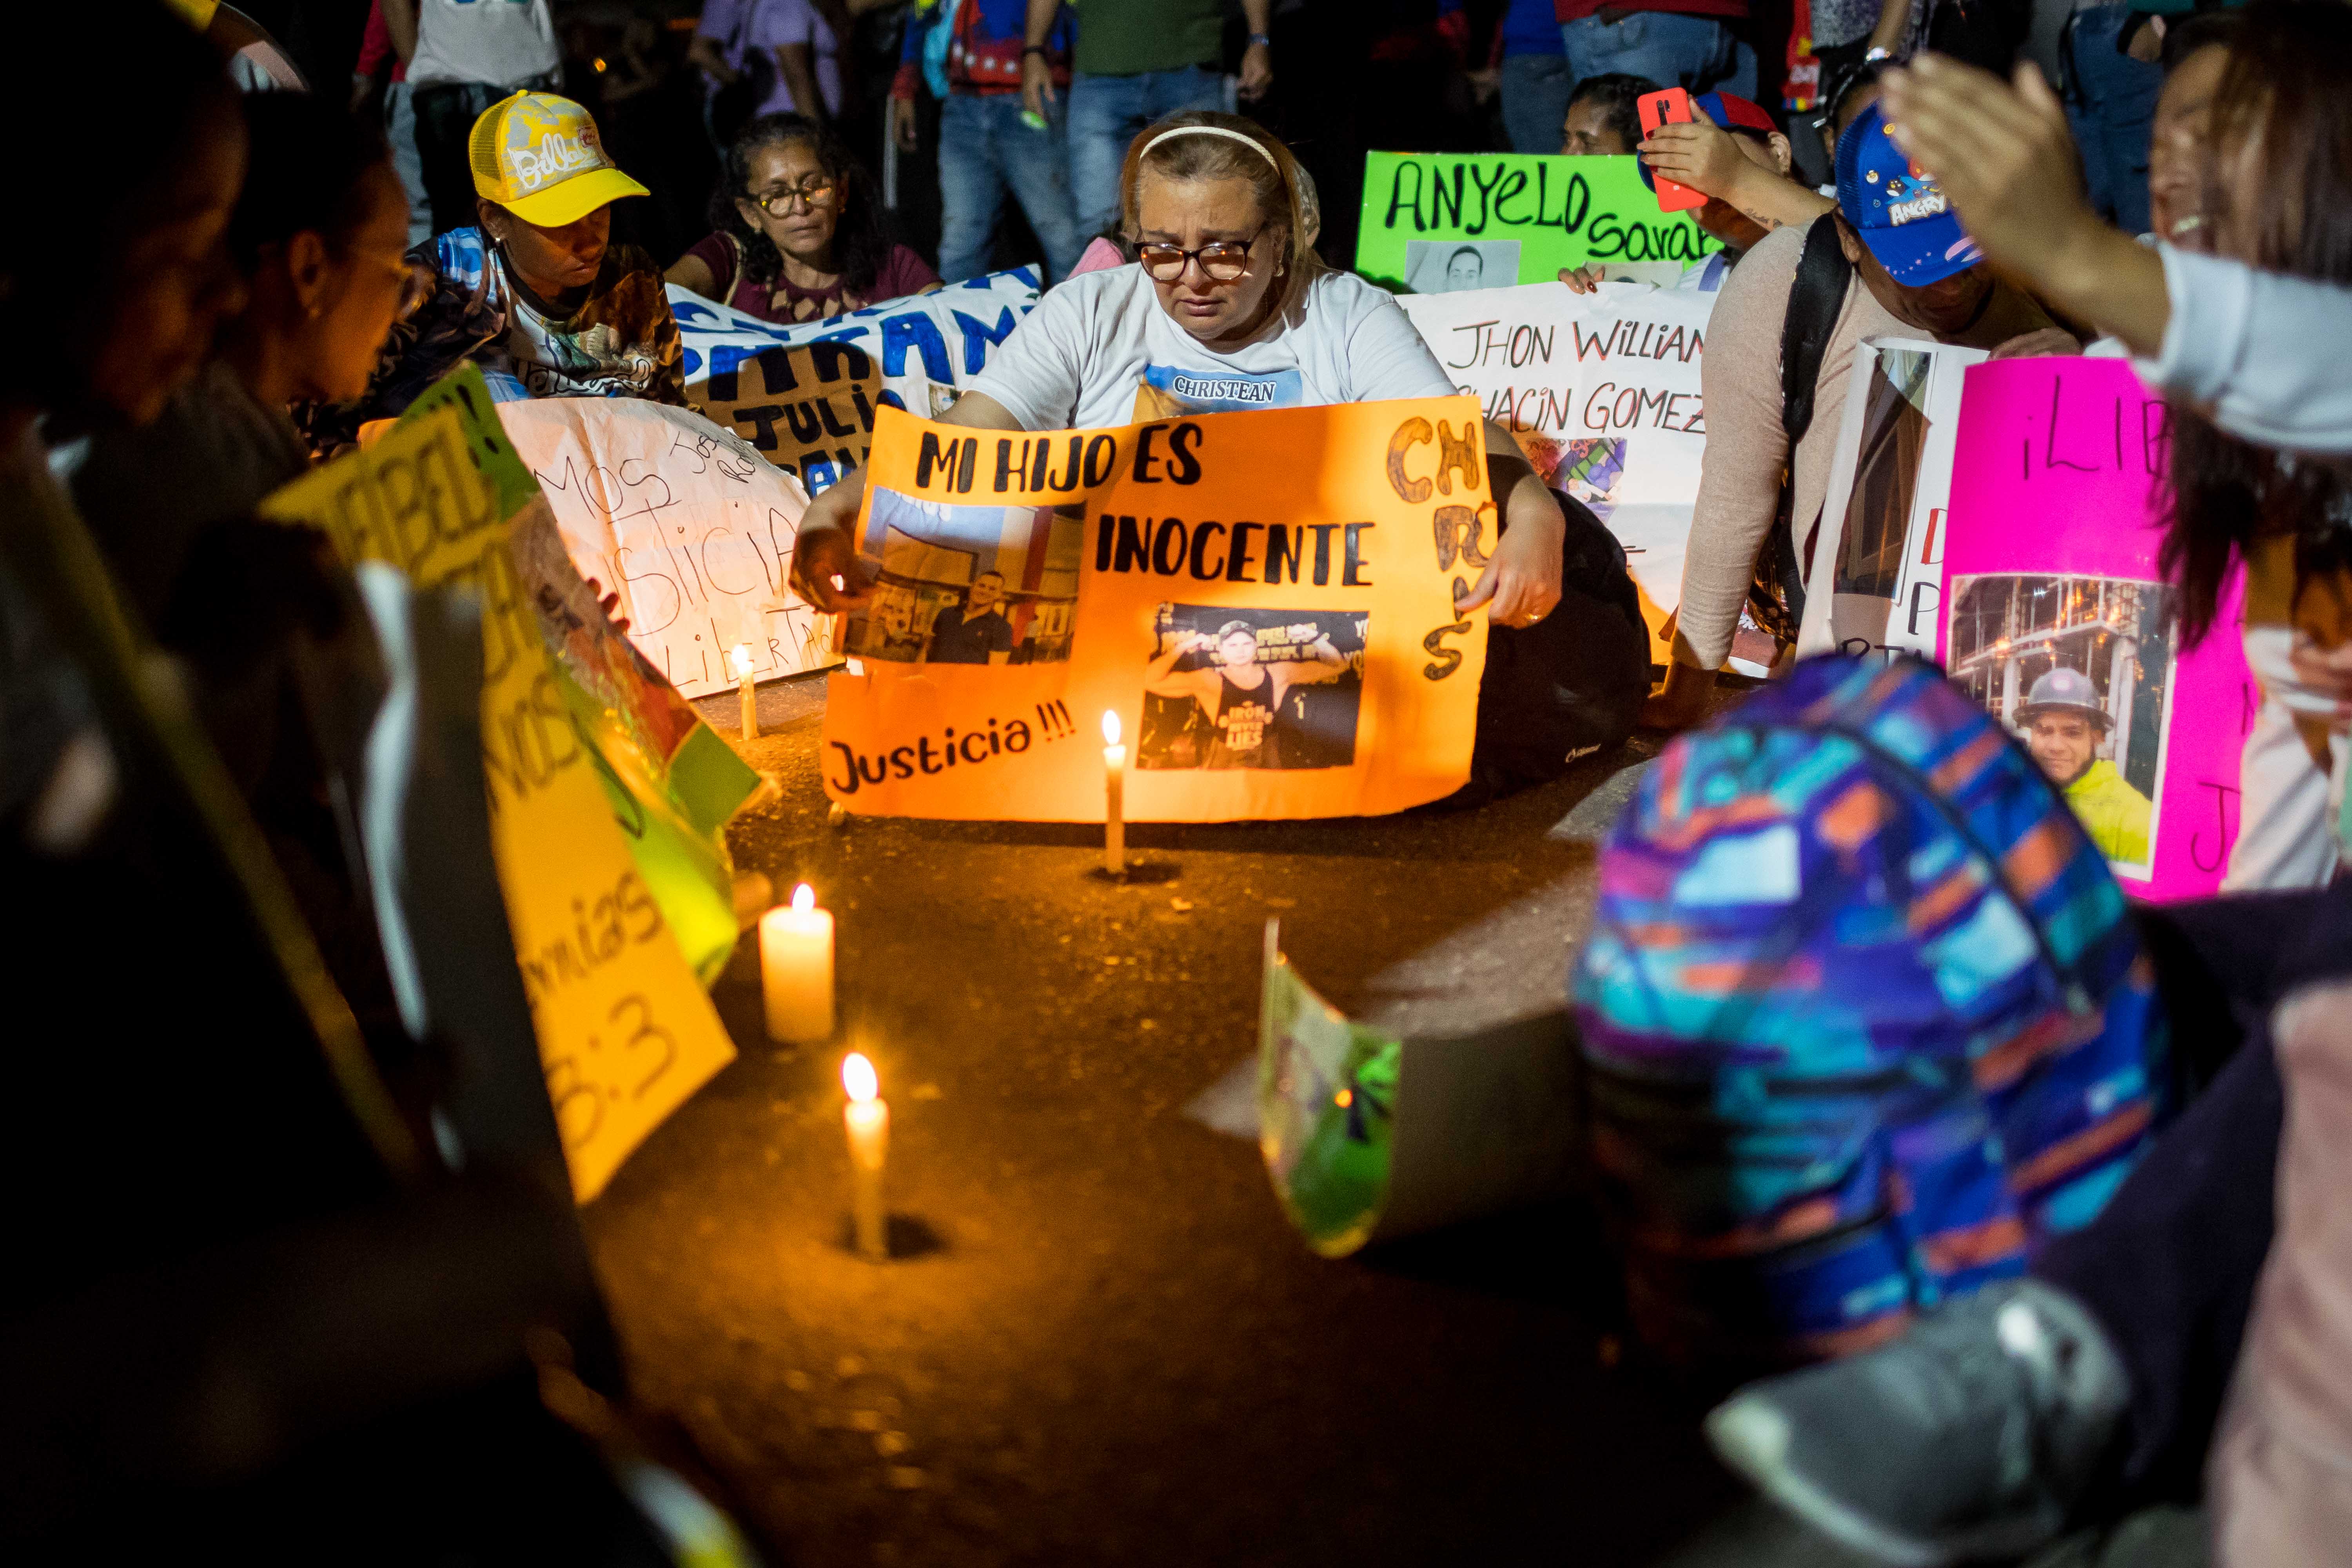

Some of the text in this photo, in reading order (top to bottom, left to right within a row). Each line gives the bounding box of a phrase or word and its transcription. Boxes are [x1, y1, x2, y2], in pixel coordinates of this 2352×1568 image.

[1889, 194, 1947, 227] ANGRY
[1447, 320, 1555, 369] JHON
[1174, 376, 1276, 403] CHRISTEAN
[1457, 382, 1706, 434] HACiN GOMEZ
[915, 432, 977, 493] MI
[993, 433, 1117, 493] HIJO
[1132, 422, 1203, 485] ES
[1096, 514, 1376, 586] INOCENTE
